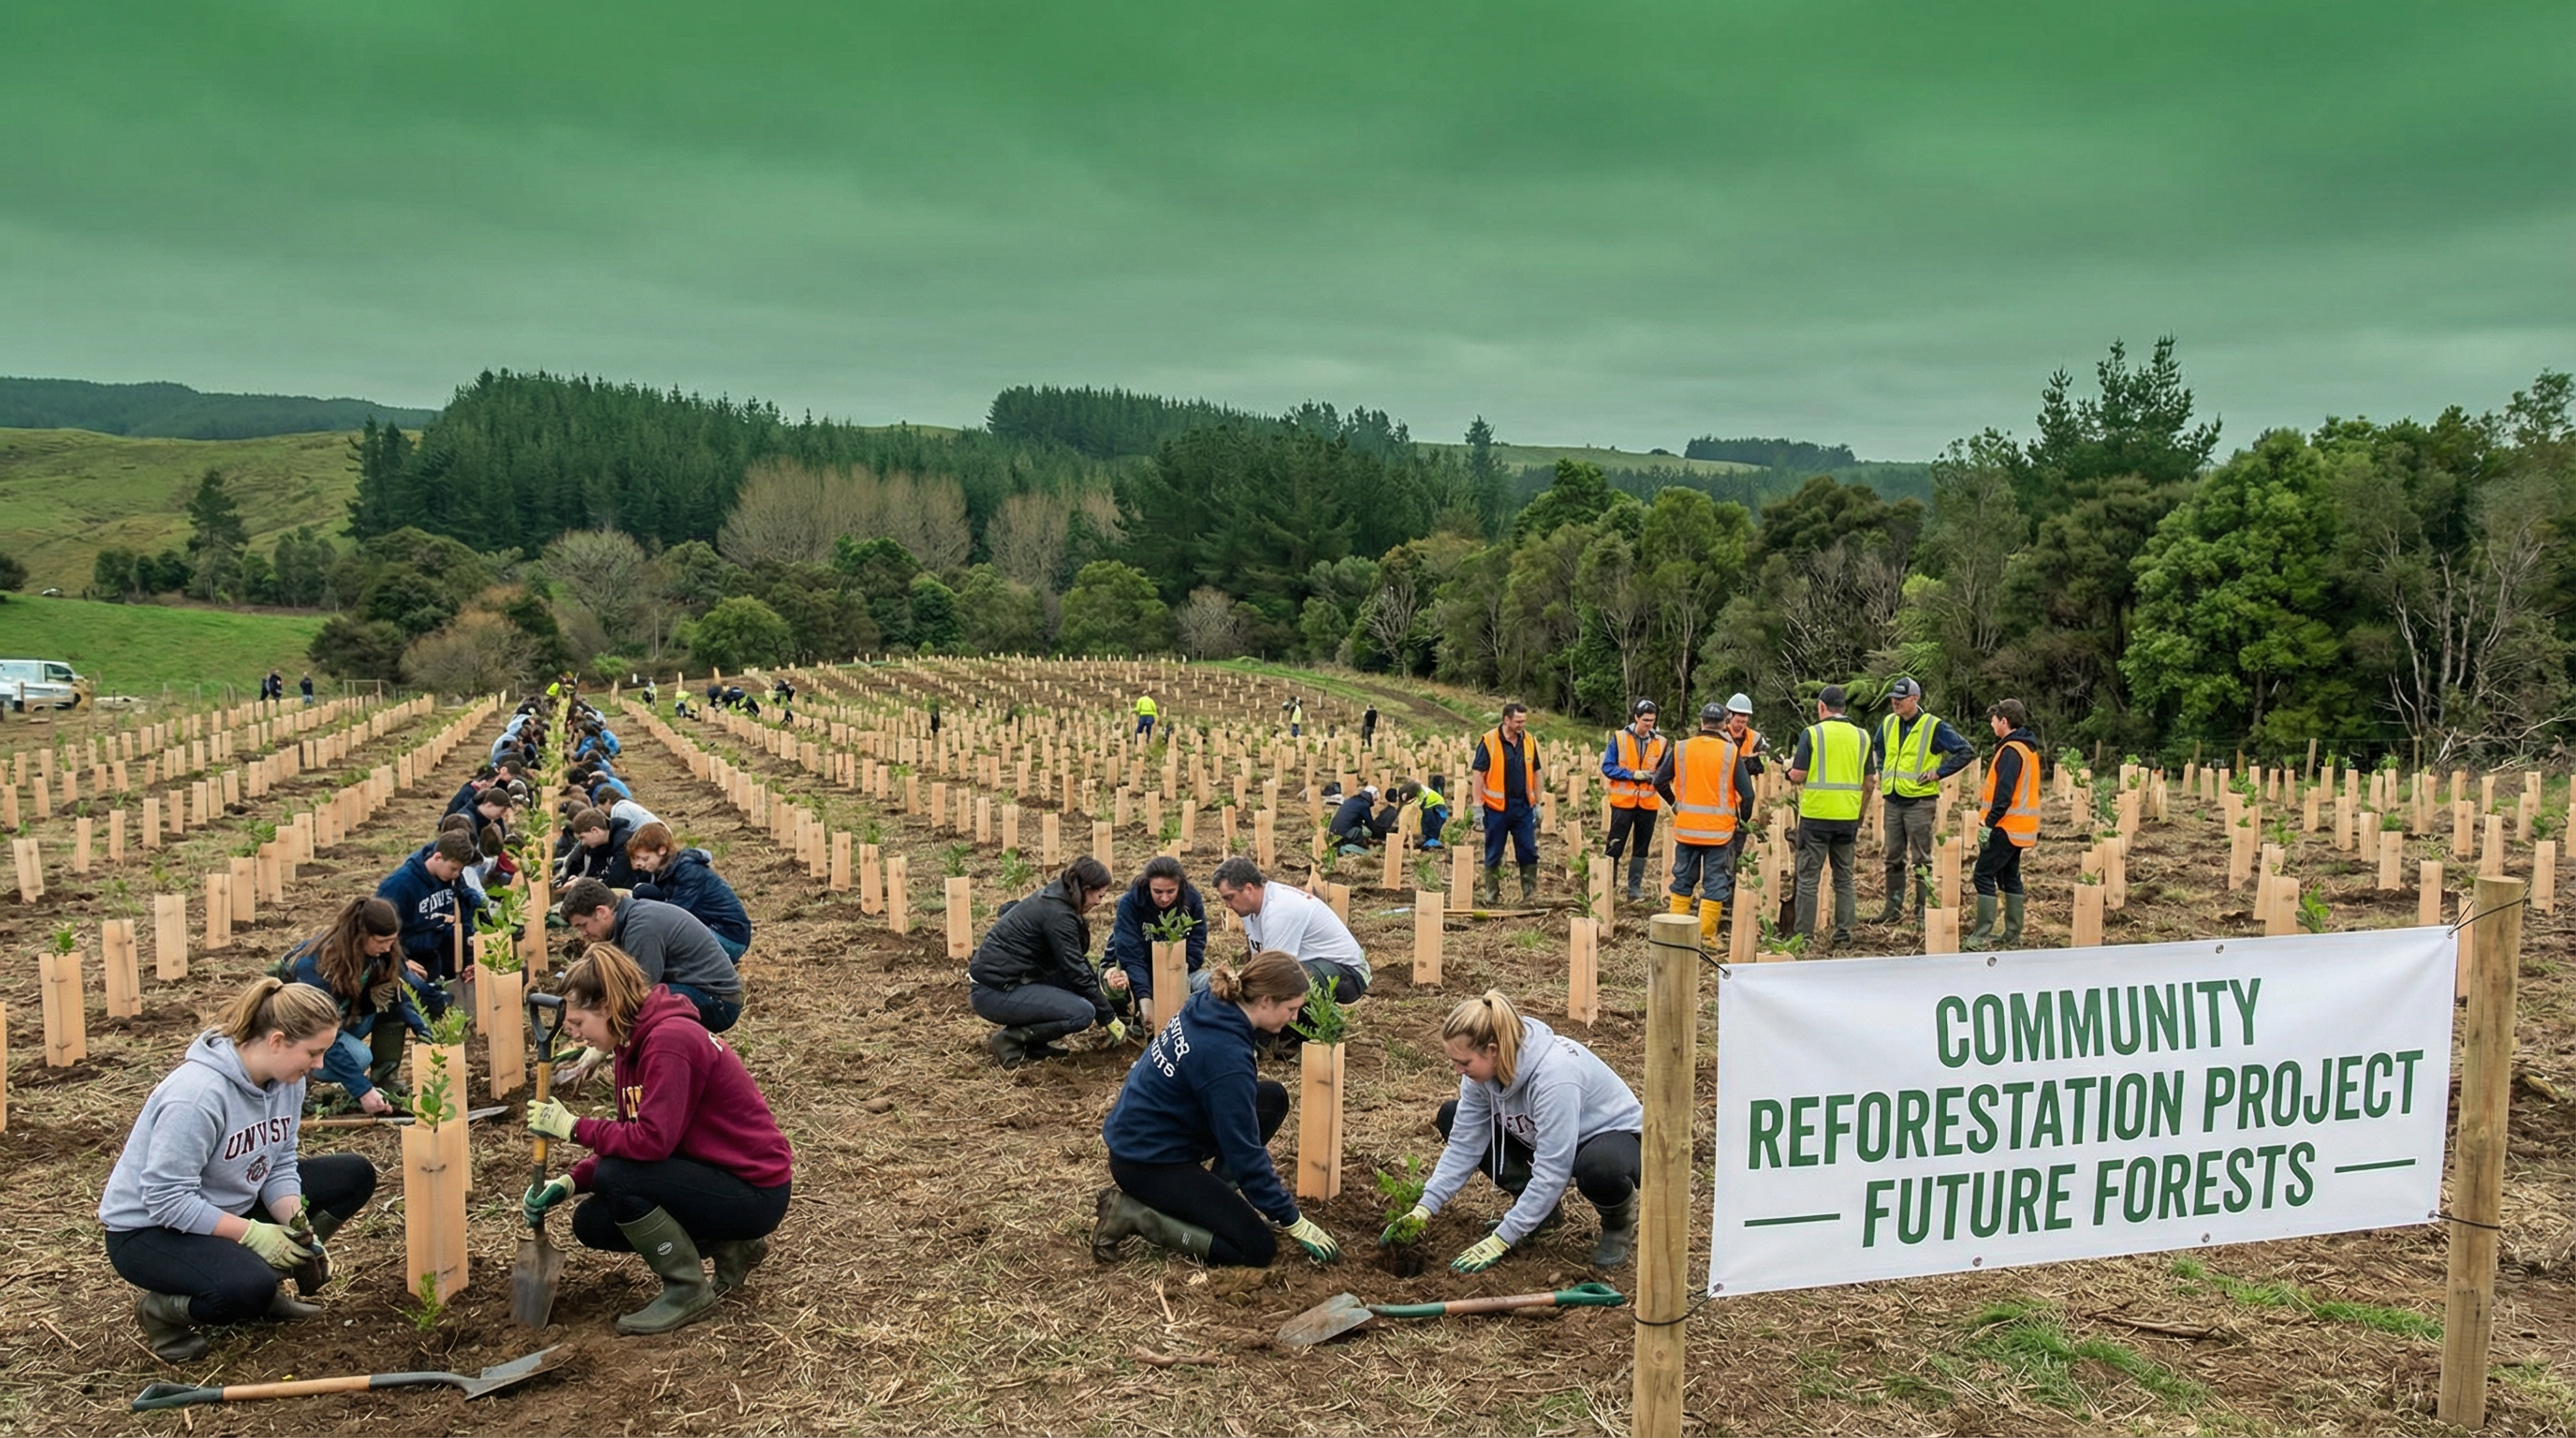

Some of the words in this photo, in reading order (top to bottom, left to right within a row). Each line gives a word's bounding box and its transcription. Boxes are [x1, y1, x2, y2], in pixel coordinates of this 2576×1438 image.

[1936, 977, 2262, 1068] COMMUNITY
[1748, 1070, 2185, 1170] REFORESTATION
[2203, 1049, 2423, 1132] PROJECT
[1863, 1165, 2076, 1249] FUTURE
[2093, 1141, 2316, 1226] FORESTS
